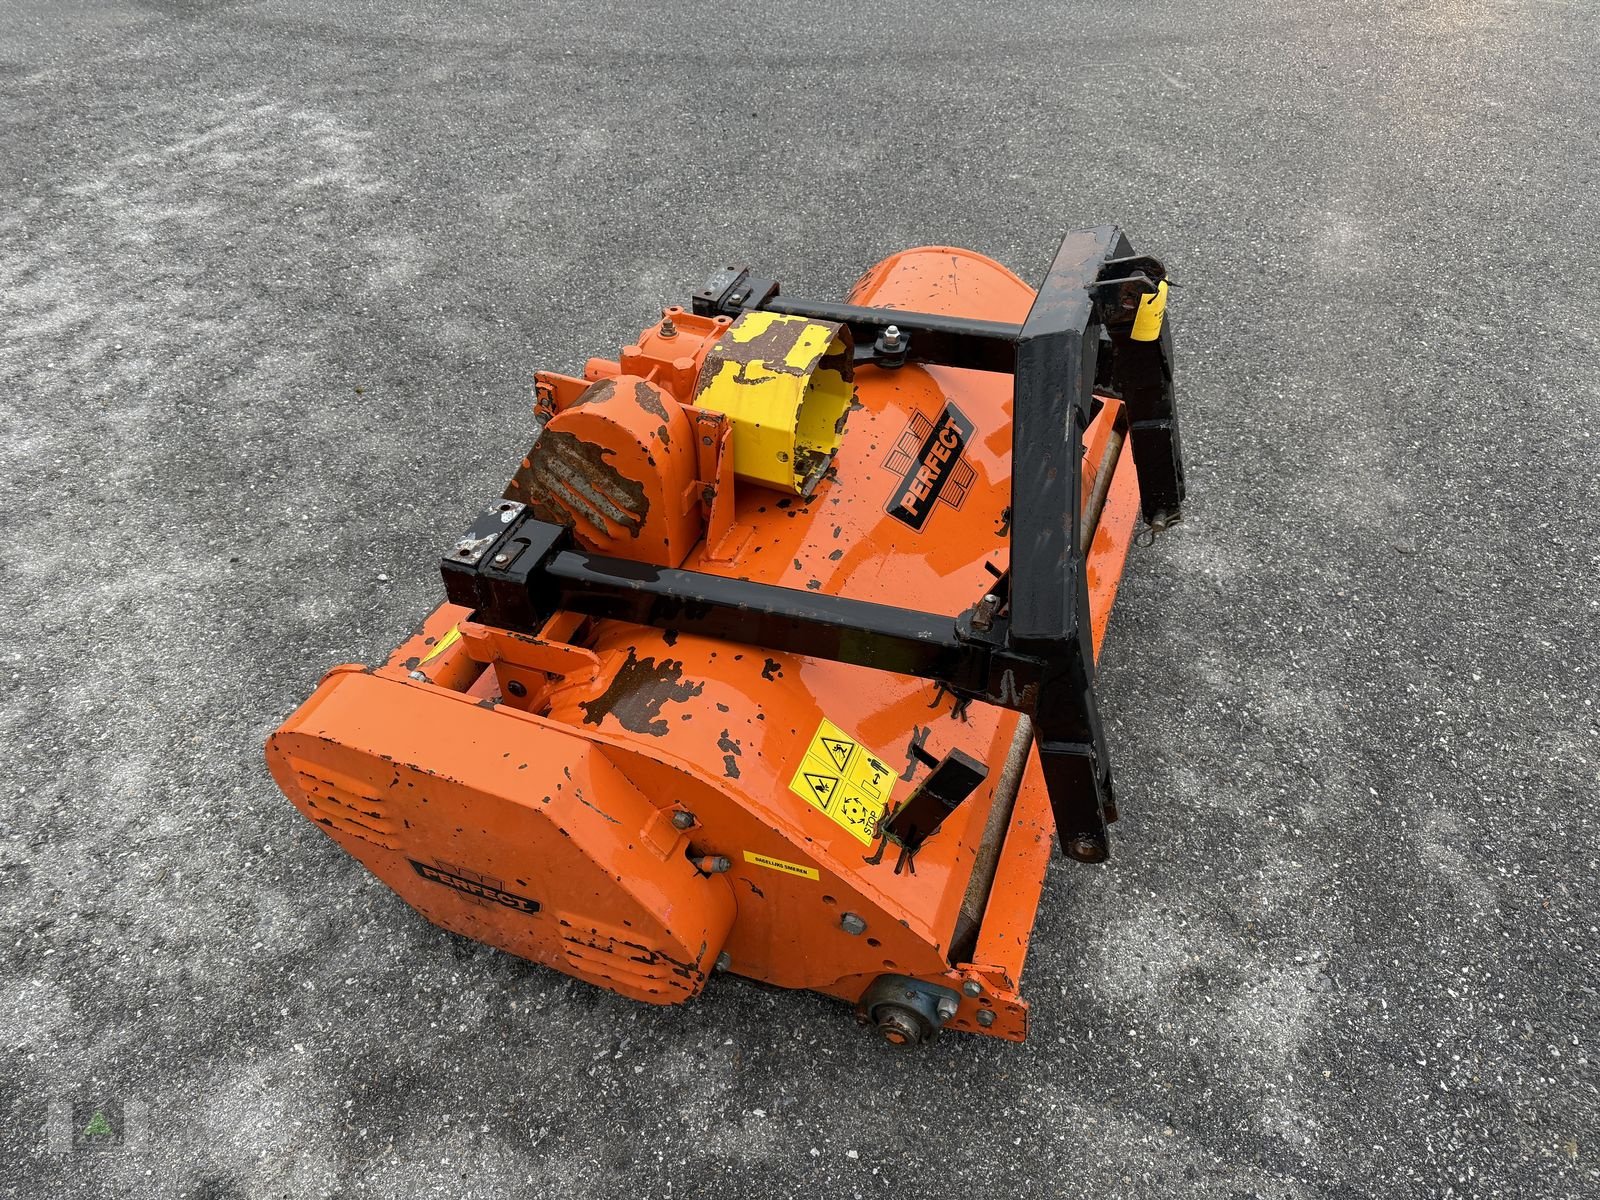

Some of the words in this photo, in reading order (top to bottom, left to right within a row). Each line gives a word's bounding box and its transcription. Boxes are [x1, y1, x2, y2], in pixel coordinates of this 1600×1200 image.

[900, 416, 963, 517] PERFECT
[863, 810, 878, 835] STOP
[784, 864, 808, 875] SMEREN
[422, 866, 534, 911] PERFECT
